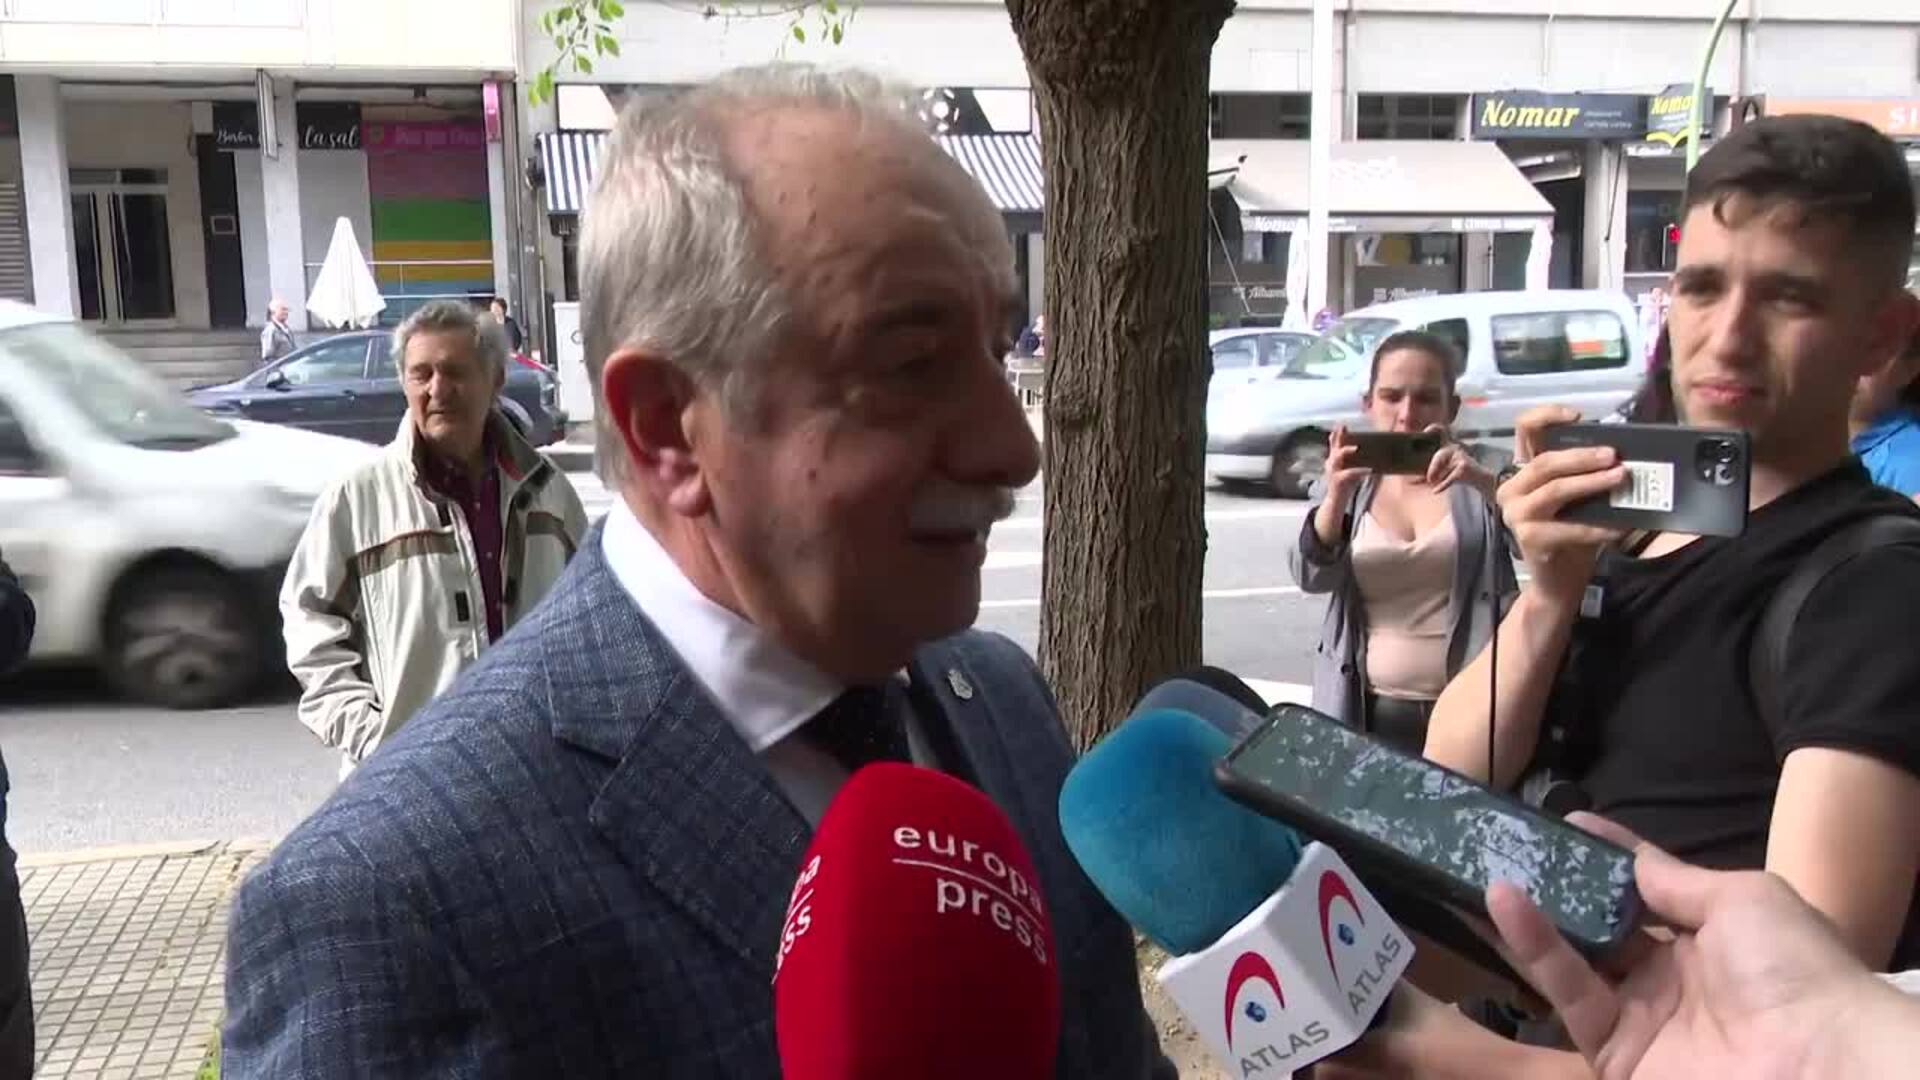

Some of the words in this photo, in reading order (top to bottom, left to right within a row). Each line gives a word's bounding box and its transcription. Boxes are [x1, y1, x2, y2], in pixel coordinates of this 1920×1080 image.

[1479, 98, 1580, 129] Nomar
[1650, 95, 1692, 115] Noma
[893, 826, 1043, 915] europa
[936, 878, 1048, 966] press
[1347, 932, 1402, 1016] ATLAS
[1239, 1020, 1331, 1079] ATLAS
